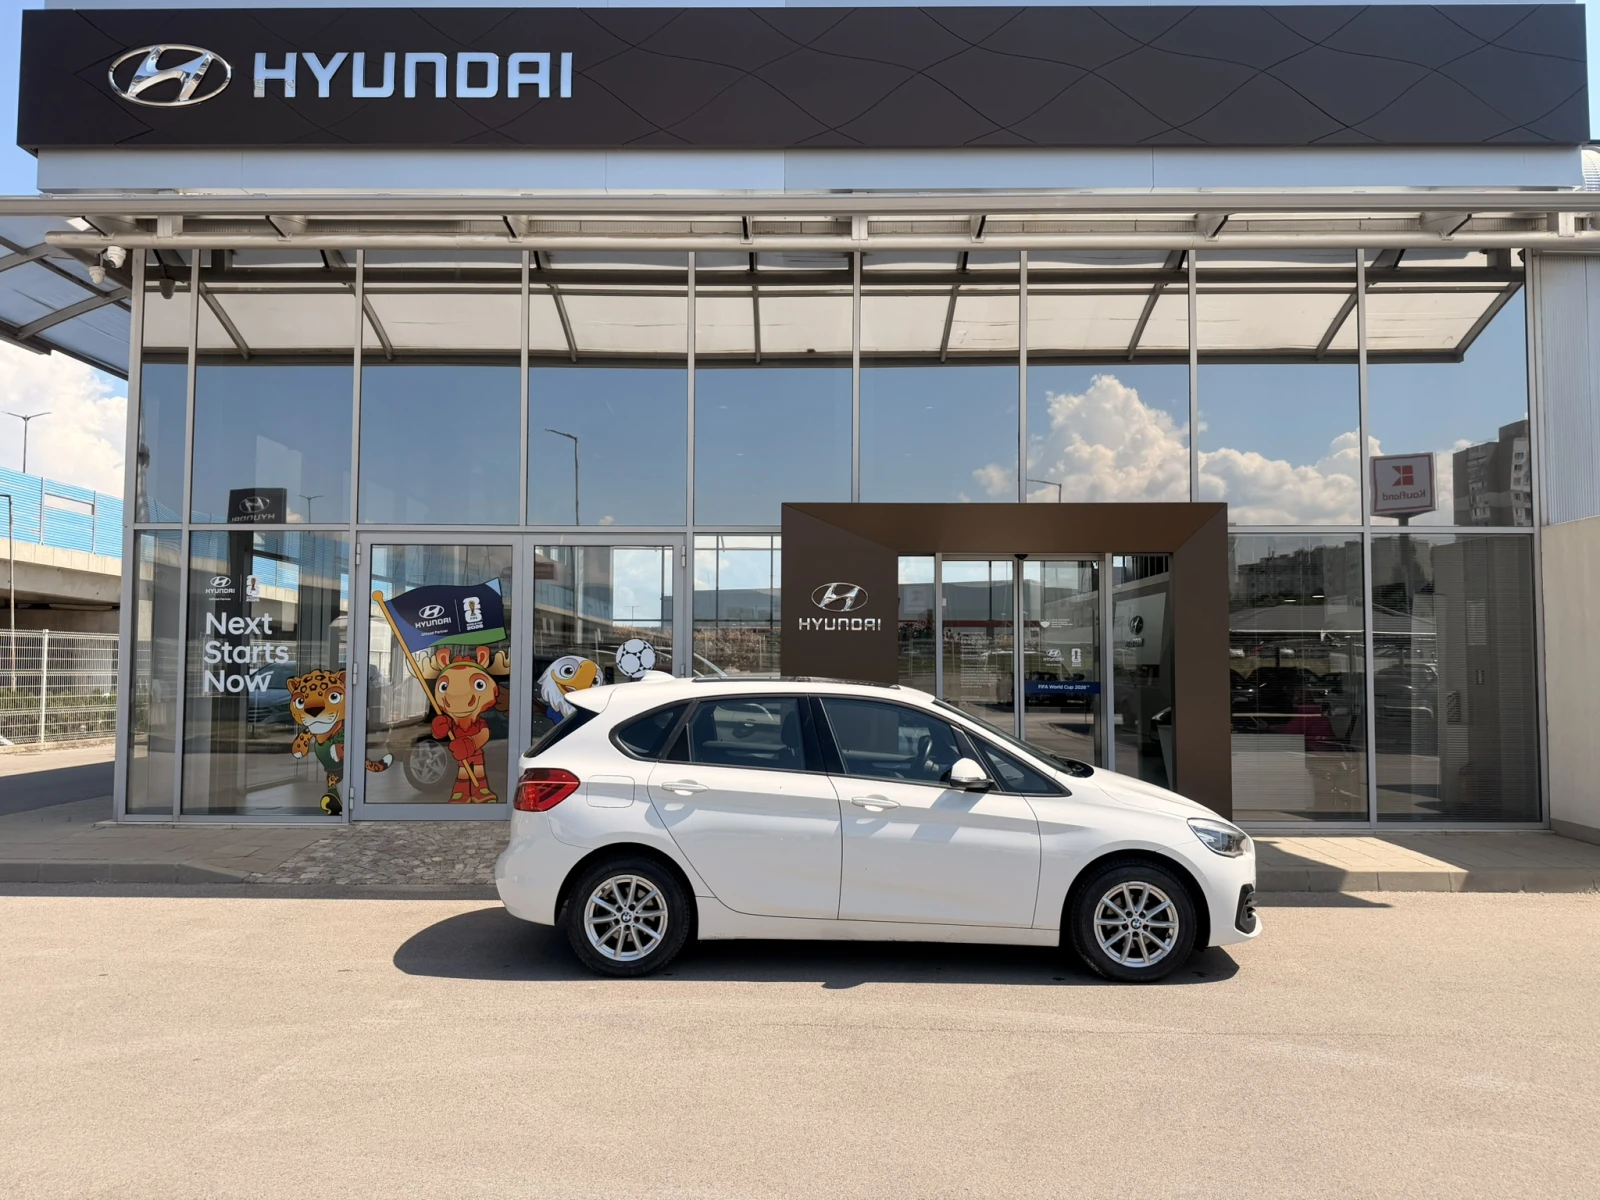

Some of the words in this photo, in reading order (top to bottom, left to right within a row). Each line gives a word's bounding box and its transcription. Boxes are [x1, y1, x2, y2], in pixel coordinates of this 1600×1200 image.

[253, 52, 573, 98] HYUNDAI
[206, 612, 273, 635] Next
[414, 617, 452, 629] HYUNDAI
[798, 617, 882, 631] HYUNDAI
[203, 640, 289, 664] Starts
[204, 670, 272, 692] Now
